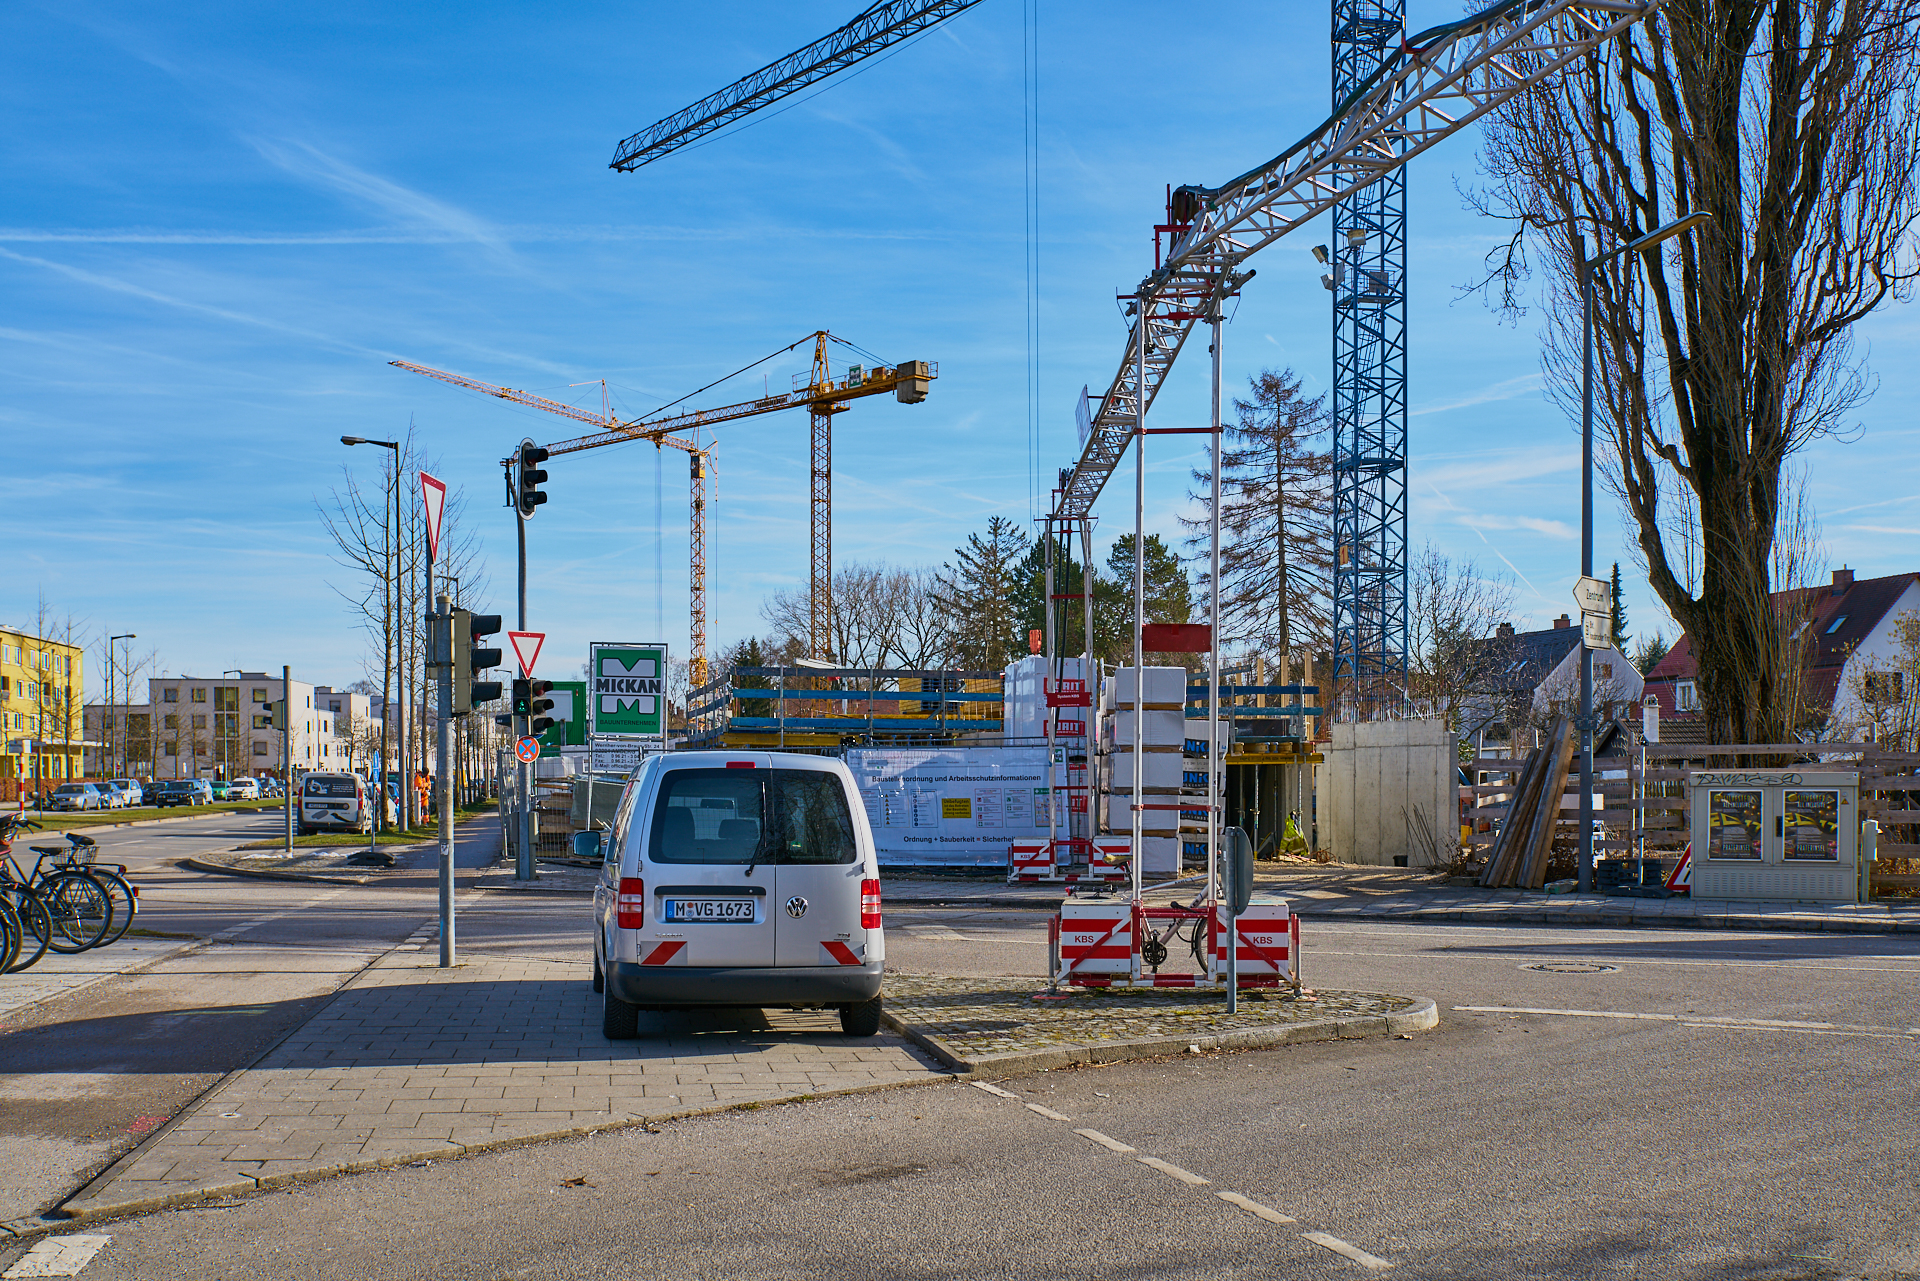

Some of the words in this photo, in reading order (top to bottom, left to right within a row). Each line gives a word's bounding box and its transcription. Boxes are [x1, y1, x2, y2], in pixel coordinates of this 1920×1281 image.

[596, 678, 661, 693] MICKAN
[949, 774, 1041, 782] Arbeitsschutzinformationen
[675, 902, 685, 916] M
[694, 902, 713, 916] VG
[716, 902, 752, 916] 1673
[1074, 935, 1094, 943] KBS
[1253, 936, 1273, 944] KBS
